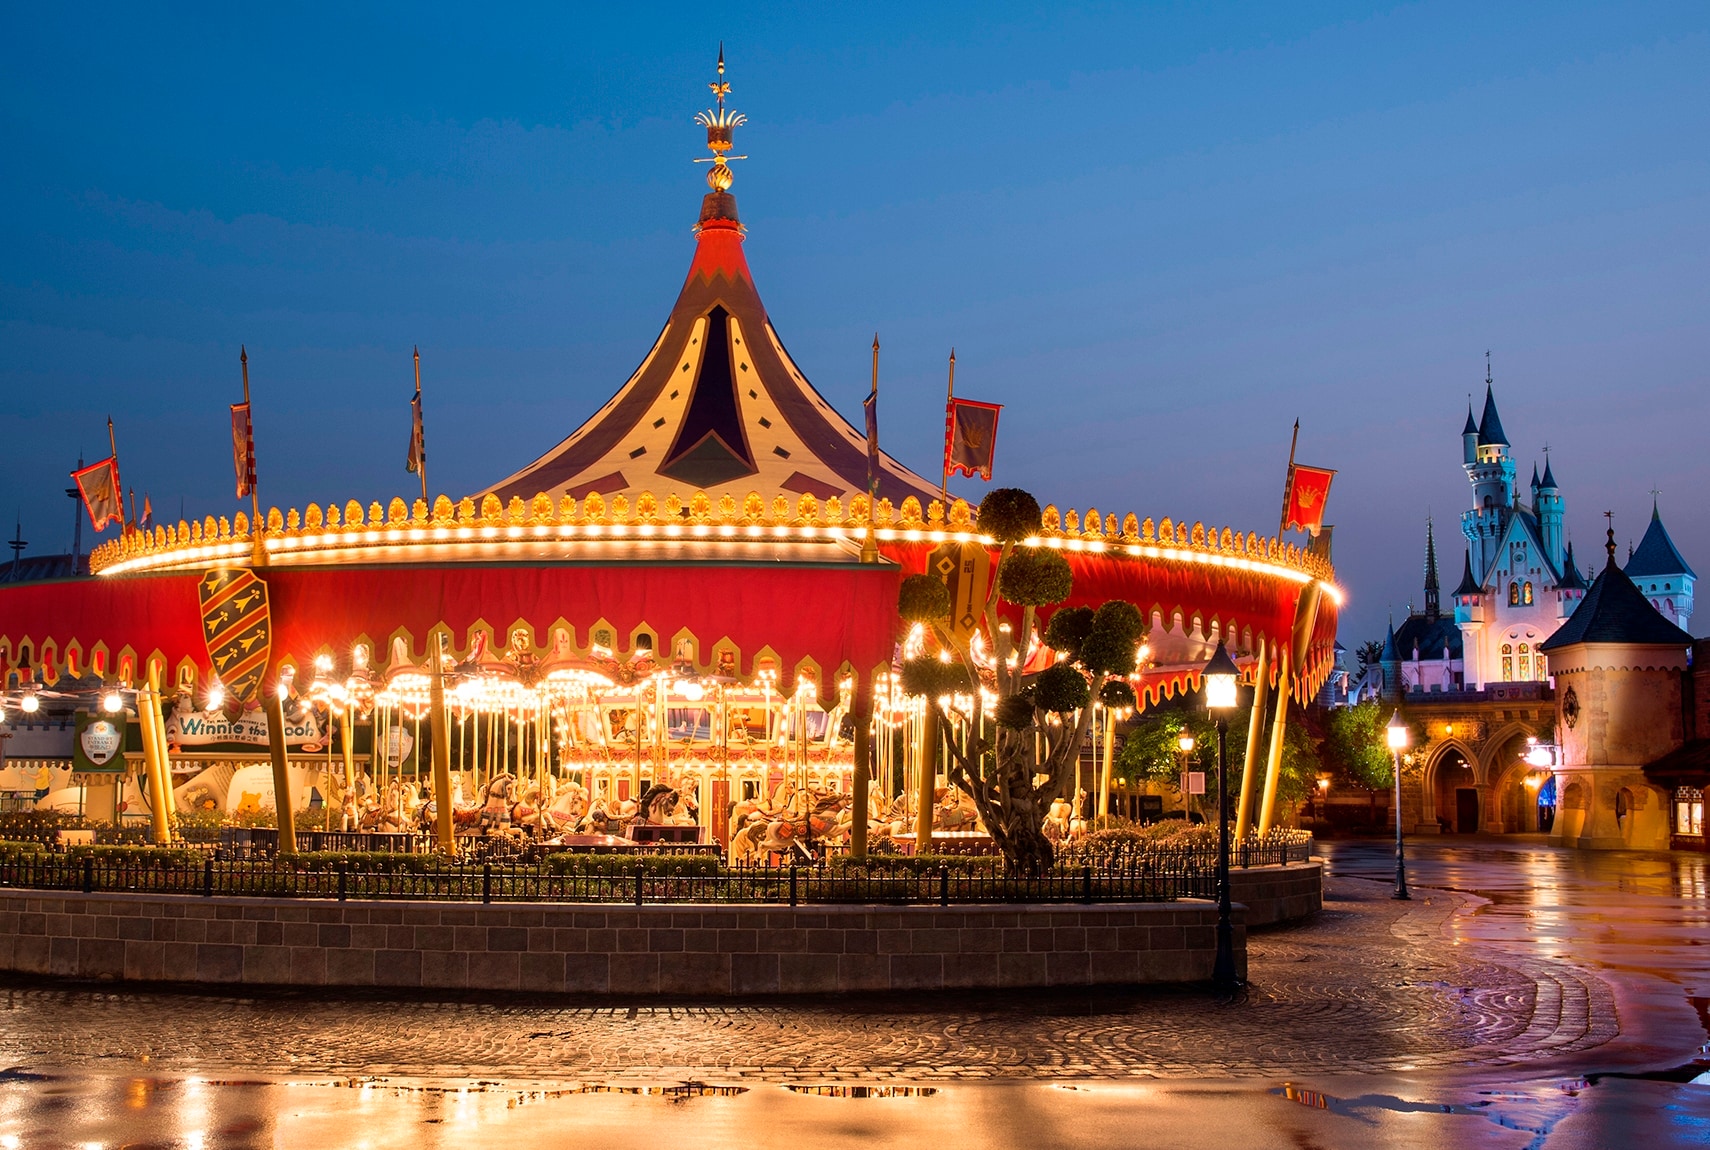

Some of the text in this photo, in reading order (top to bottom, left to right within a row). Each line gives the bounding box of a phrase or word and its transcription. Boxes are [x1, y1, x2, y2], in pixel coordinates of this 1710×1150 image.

[180, 717, 314, 737] Winnie the ooh
